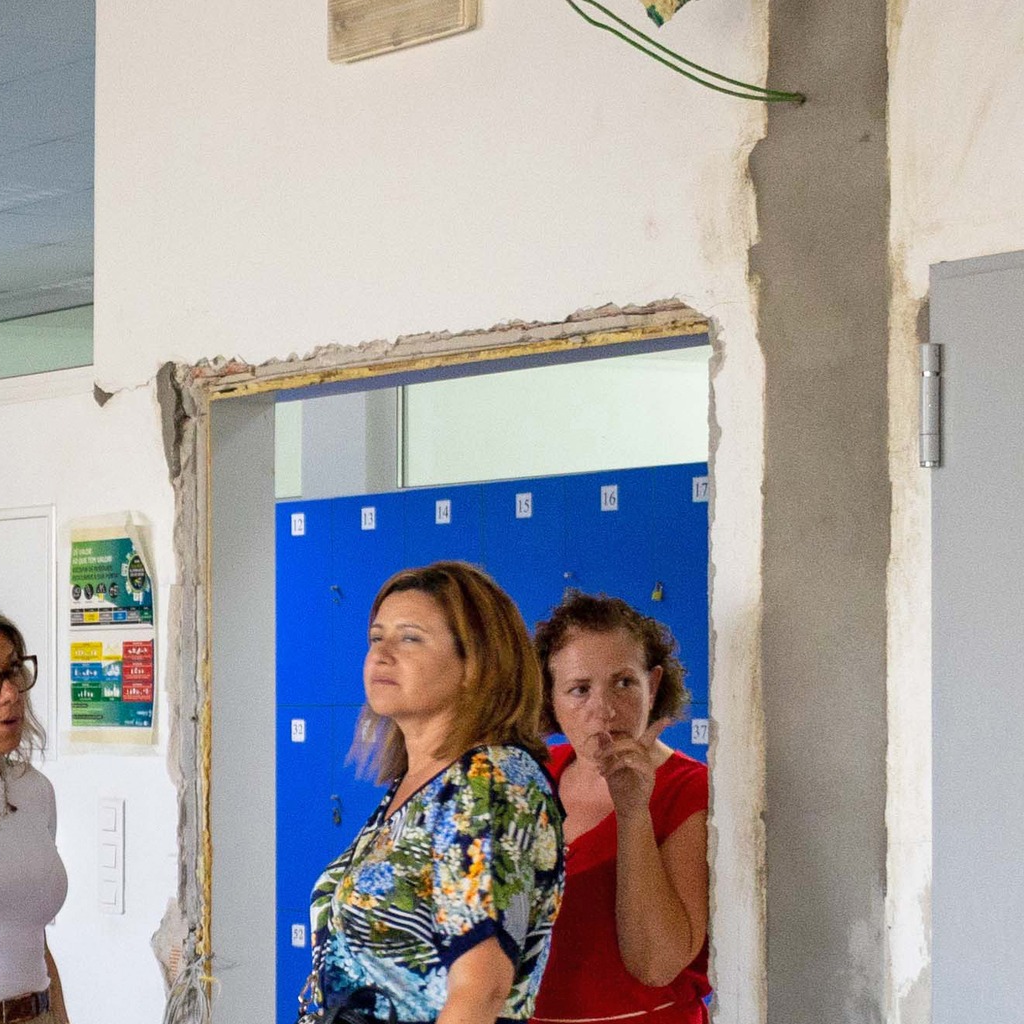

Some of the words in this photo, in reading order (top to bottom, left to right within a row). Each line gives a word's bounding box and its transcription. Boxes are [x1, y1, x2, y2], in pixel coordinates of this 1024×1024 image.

[694, 482, 708, 497] 17
[603, 492, 616, 506] 16
[437, 505, 449, 519] 14
[517, 499, 530, 513] 15
[292, 519, 303, 531] 12
[363, 512, 373, 525] 13
[293, 725, 303, 735] 32
[693, 726, 707, 739] 37
[293, 928, 303, 940] 52
